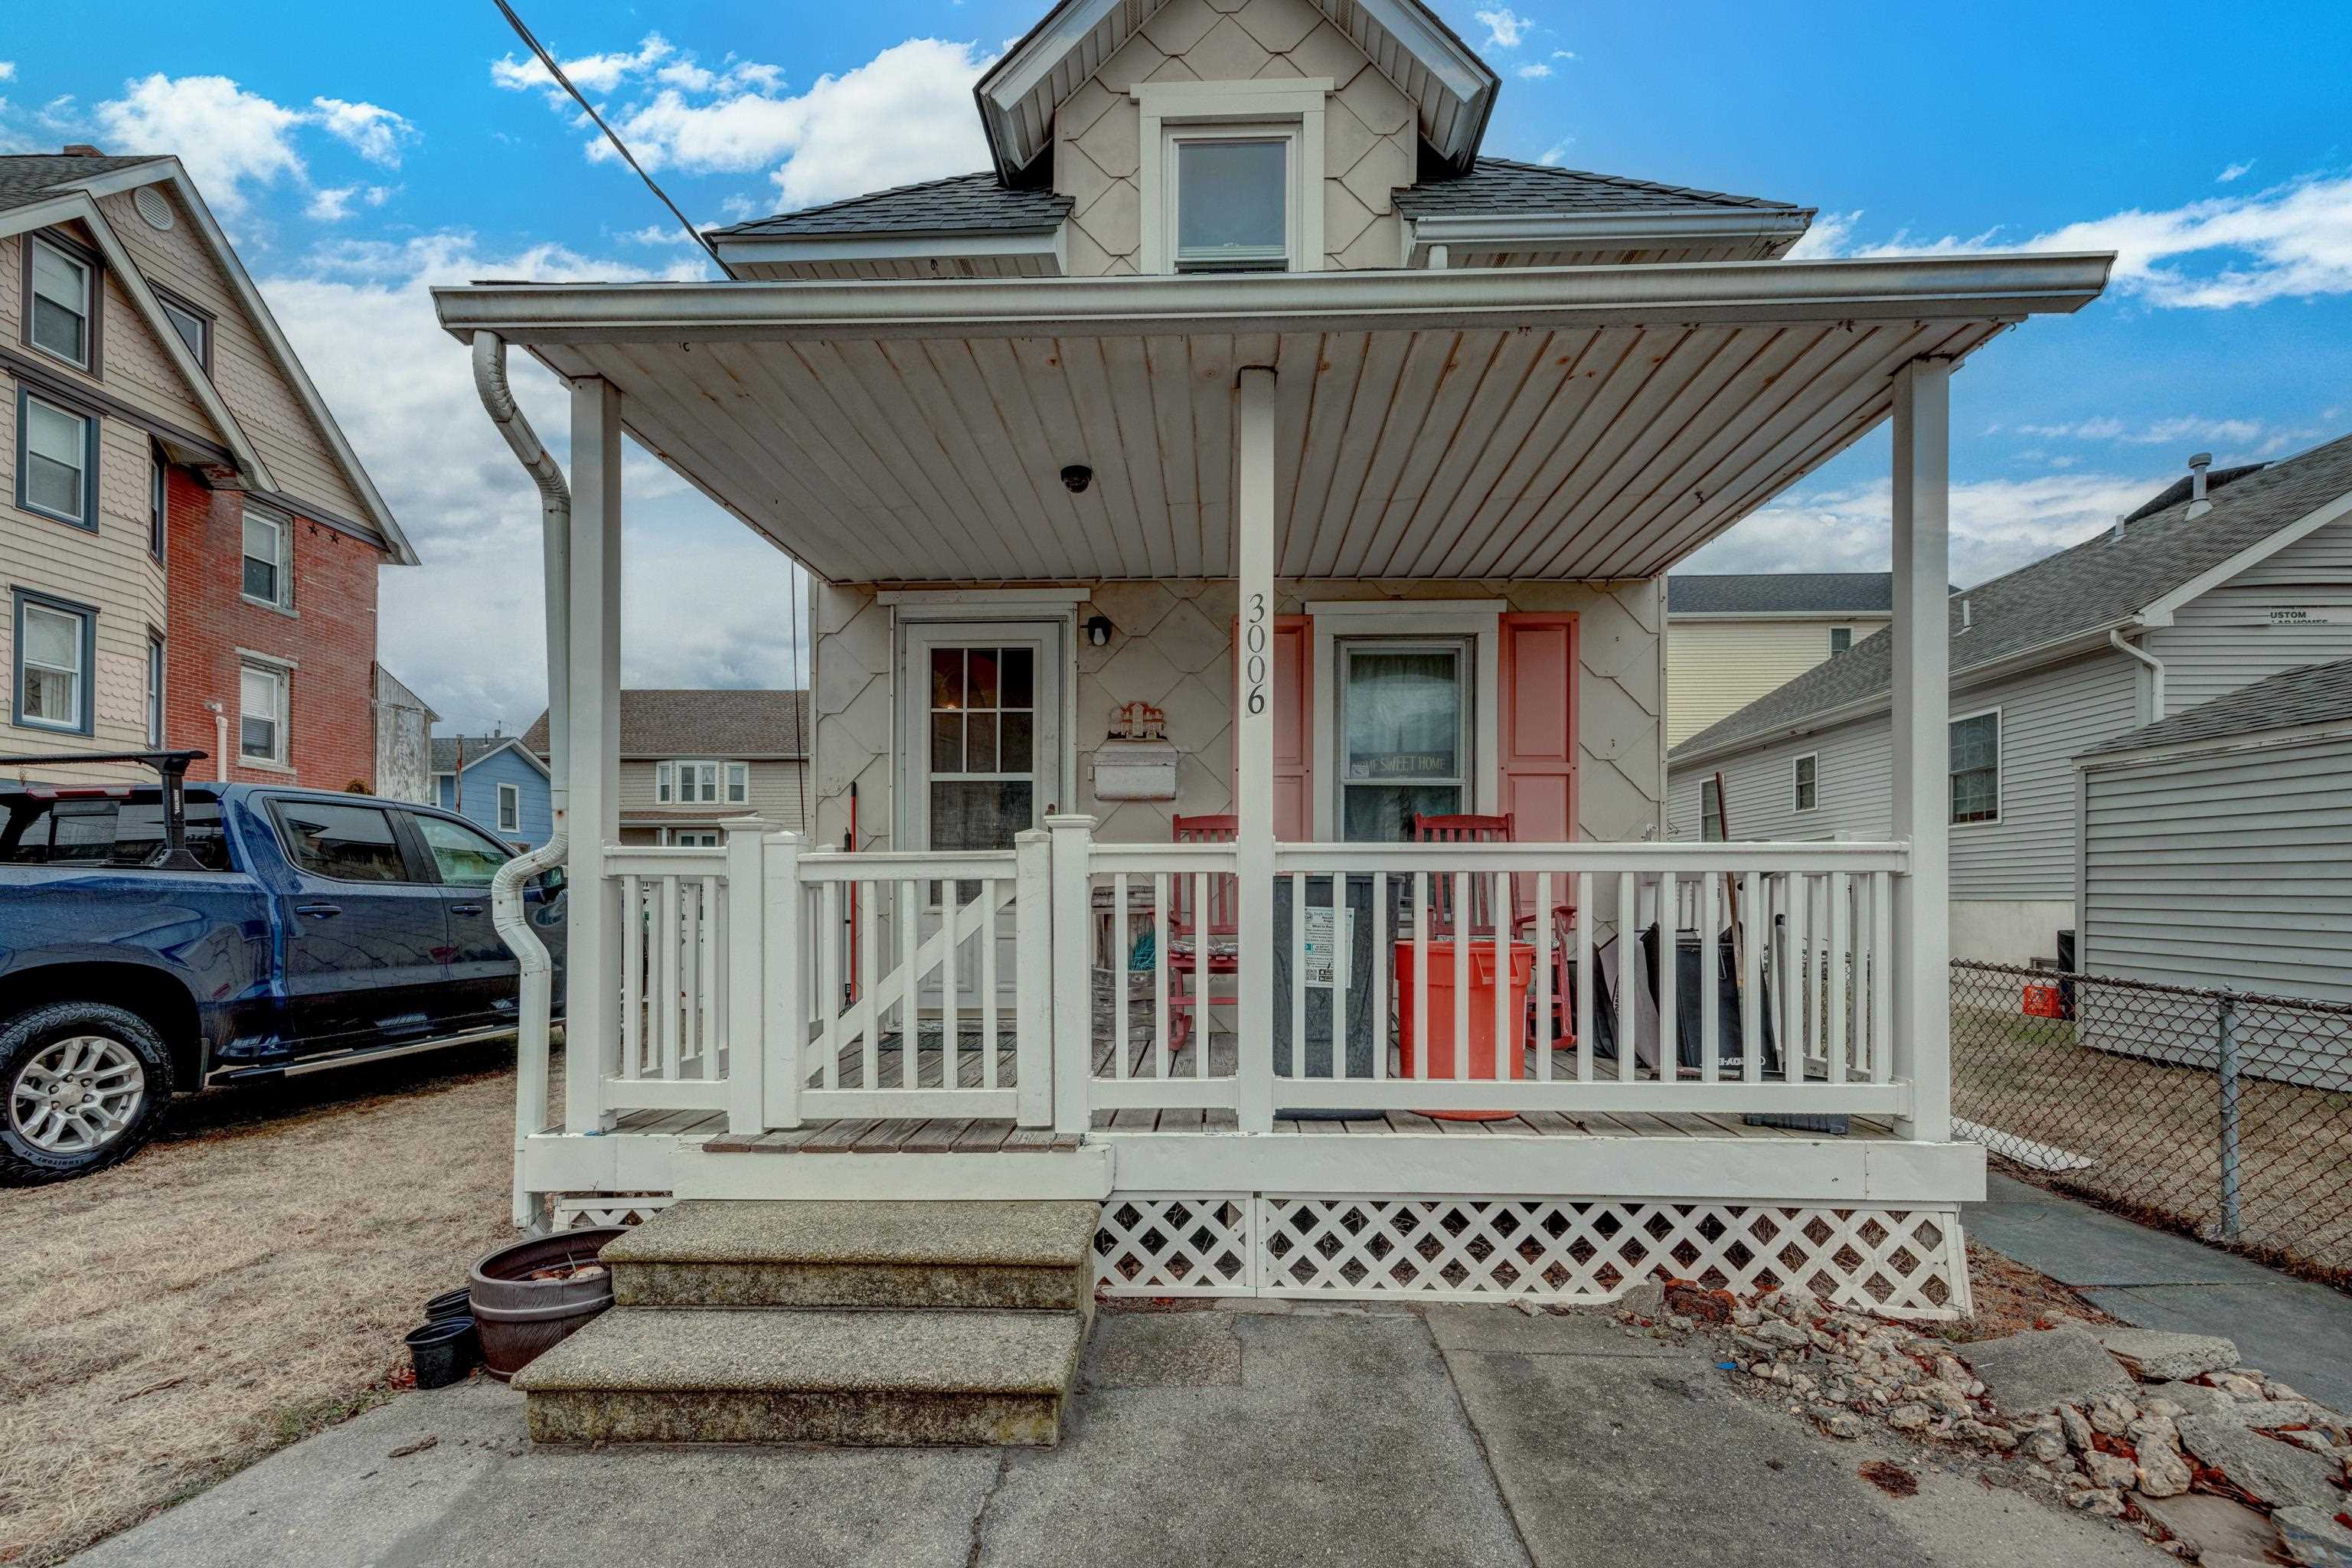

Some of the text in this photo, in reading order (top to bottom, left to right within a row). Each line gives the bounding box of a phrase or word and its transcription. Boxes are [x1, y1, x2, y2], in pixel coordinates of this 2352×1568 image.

[1248, 593, 1265, 714] 3006
[1380, 756, 1416, 773] SWEET
[1419, 756, 1446, 773] HOME
[36, 1157, 84, 1165] TERRITORY
